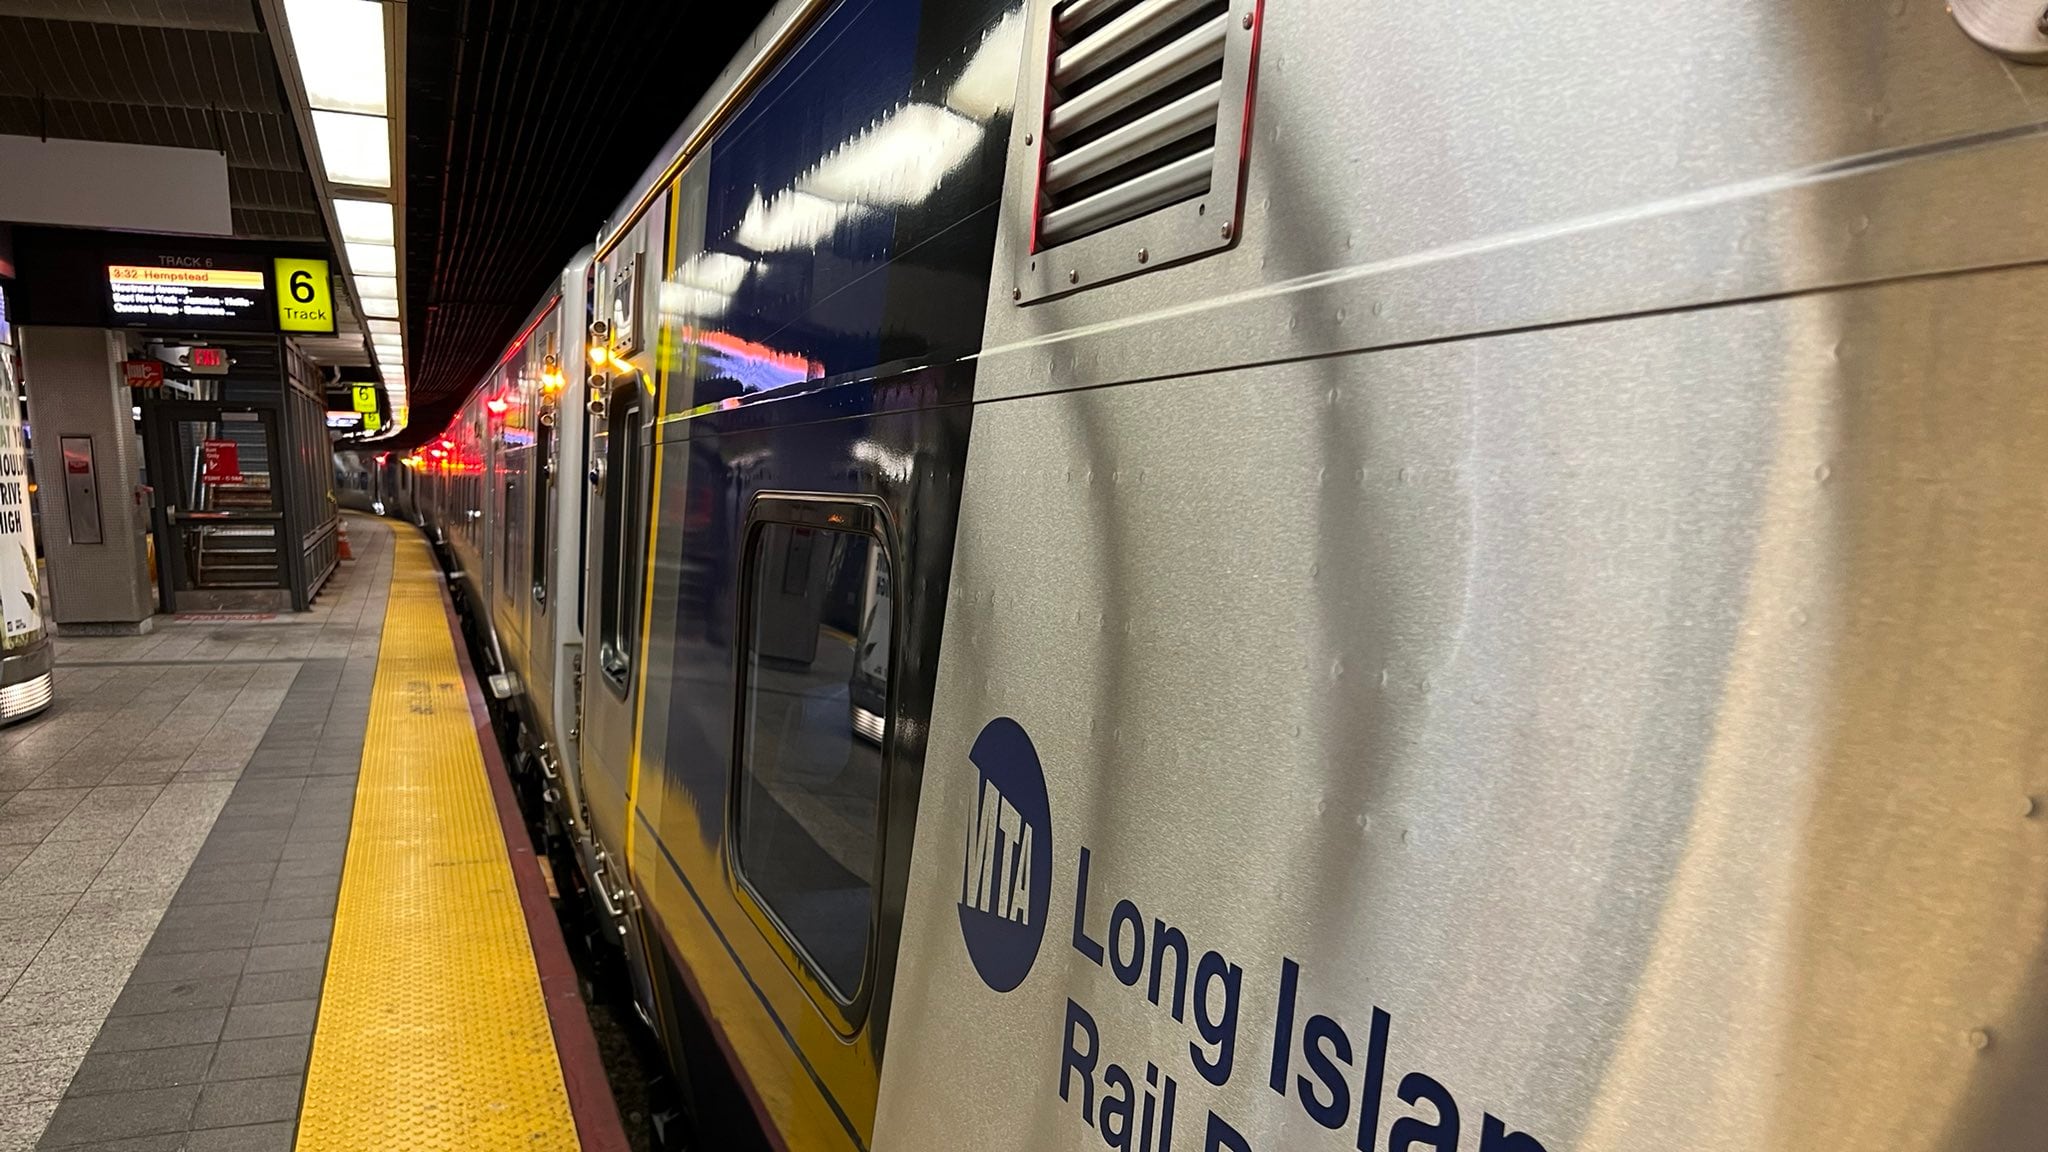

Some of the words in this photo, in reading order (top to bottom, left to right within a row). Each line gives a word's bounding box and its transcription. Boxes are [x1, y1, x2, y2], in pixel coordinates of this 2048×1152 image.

[158, 255, 200, 267] TRACK
[205, 257, 214, 267] 6
[113, 268, 138, 279] 3:32
[144, 269, 209, 282] Hempstead
[289, 270, 316, 304] 6
[284, 307, 327, 322] Track
[359, 386, 369, 401] 6
[1072, 846, 1243, 1086] Long
[1059, 996, 1177, 1152] Rail
